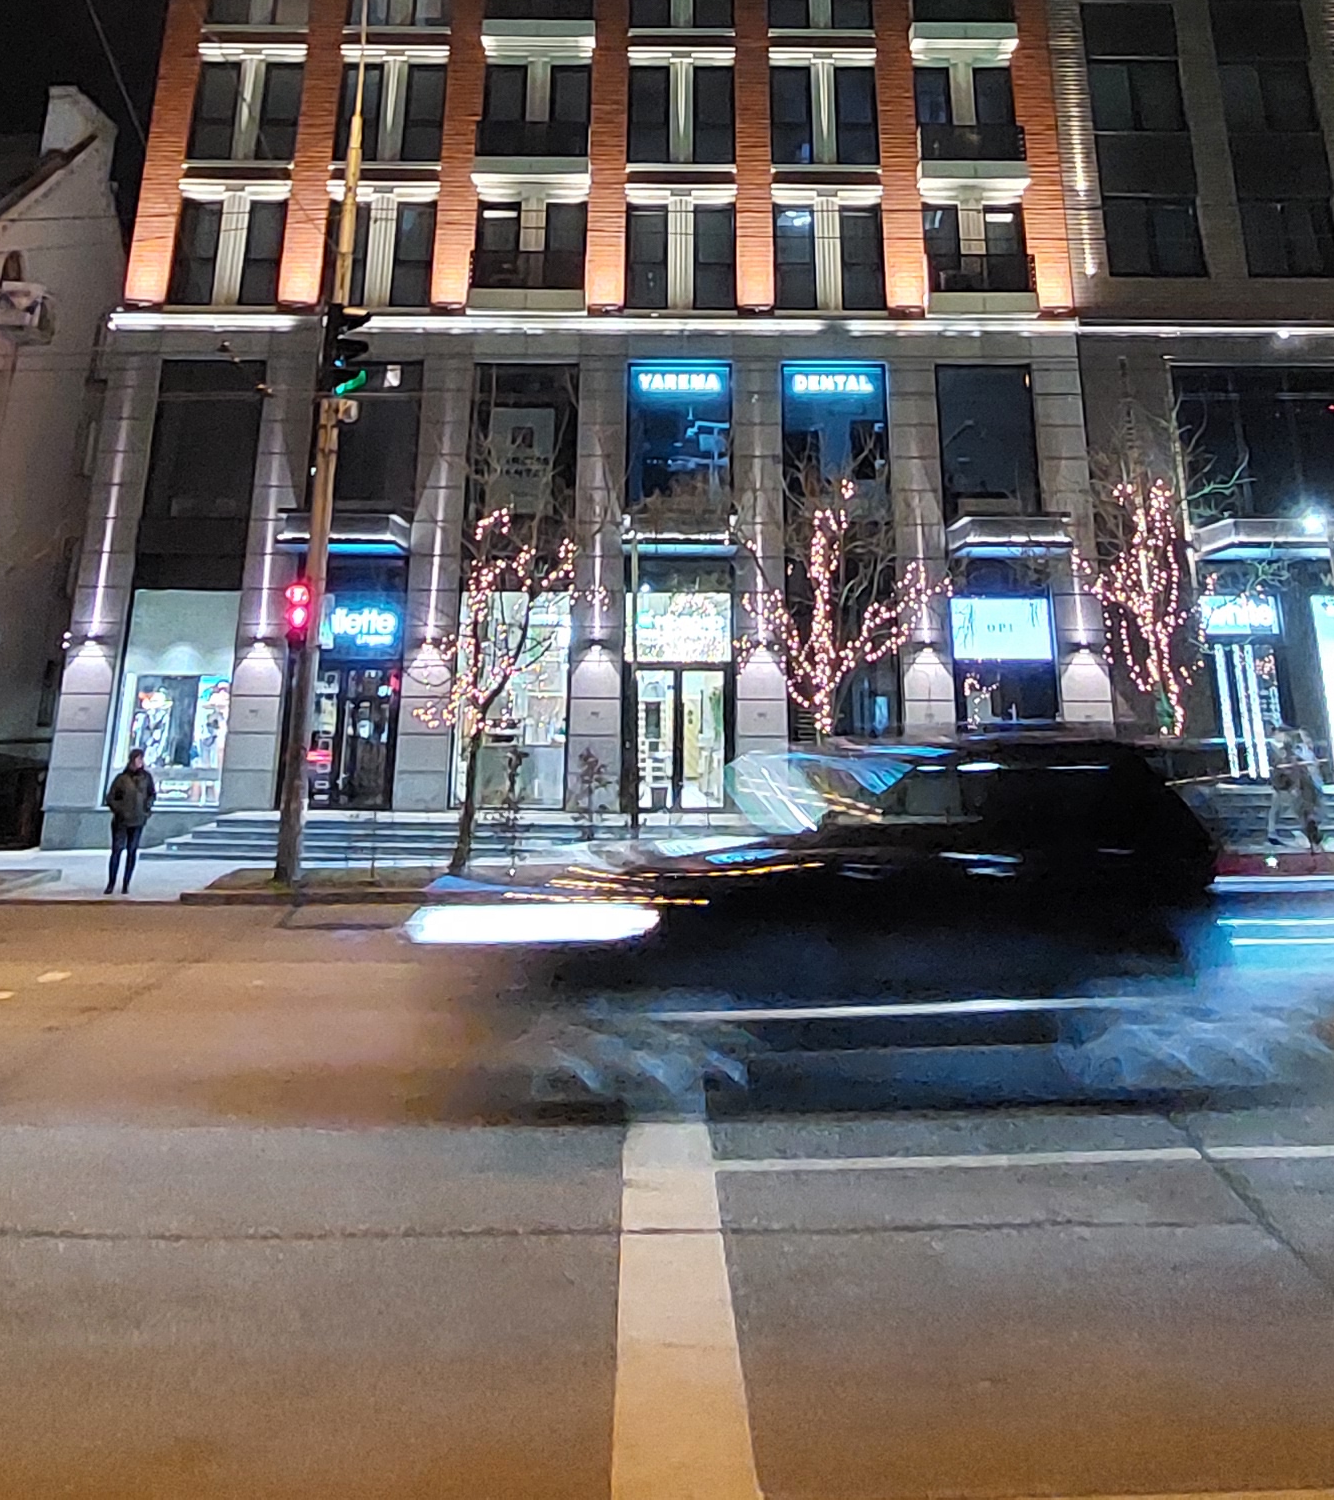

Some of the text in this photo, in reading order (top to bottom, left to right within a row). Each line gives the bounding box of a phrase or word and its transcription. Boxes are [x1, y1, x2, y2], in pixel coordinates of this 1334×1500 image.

[639, 373, 874, 392] YAREMA DENTAL
[331, 607, 397, 635] liette
[1209, 597, 1273, 627] white
